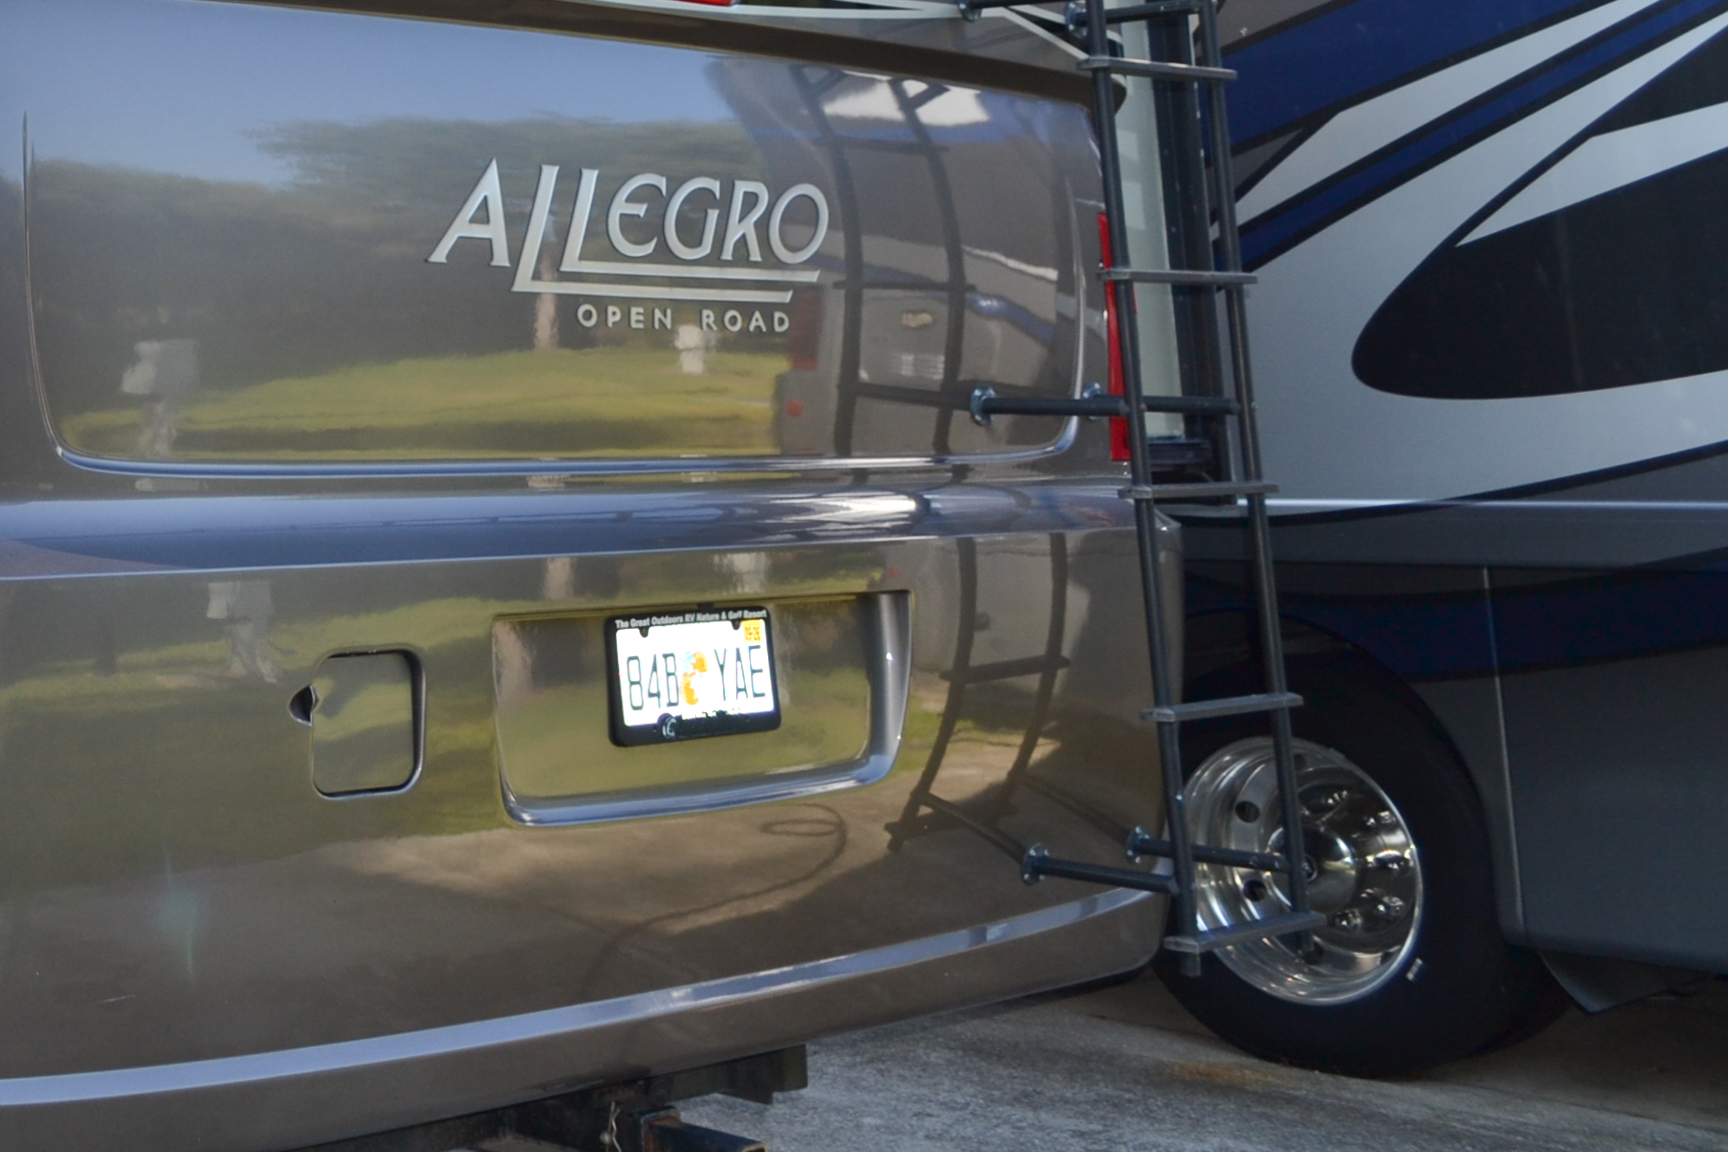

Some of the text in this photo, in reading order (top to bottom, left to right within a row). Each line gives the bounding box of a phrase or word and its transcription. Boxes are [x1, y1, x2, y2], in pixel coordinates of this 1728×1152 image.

[425, 157, 829, 303] ALLEGRO
[576, 303, 790, 333] OPEN ROAD
[615, 619, 629, 629] The
[630, 617, 650, 627] Great
[651, 615, 684, 625] Outdoors
[684, 613, 696, 622] RV
[696, 612, 720, 621] Nature
[743, 609, 767, 619] Resort
[626, 645, 766, 711] 84B YAE
